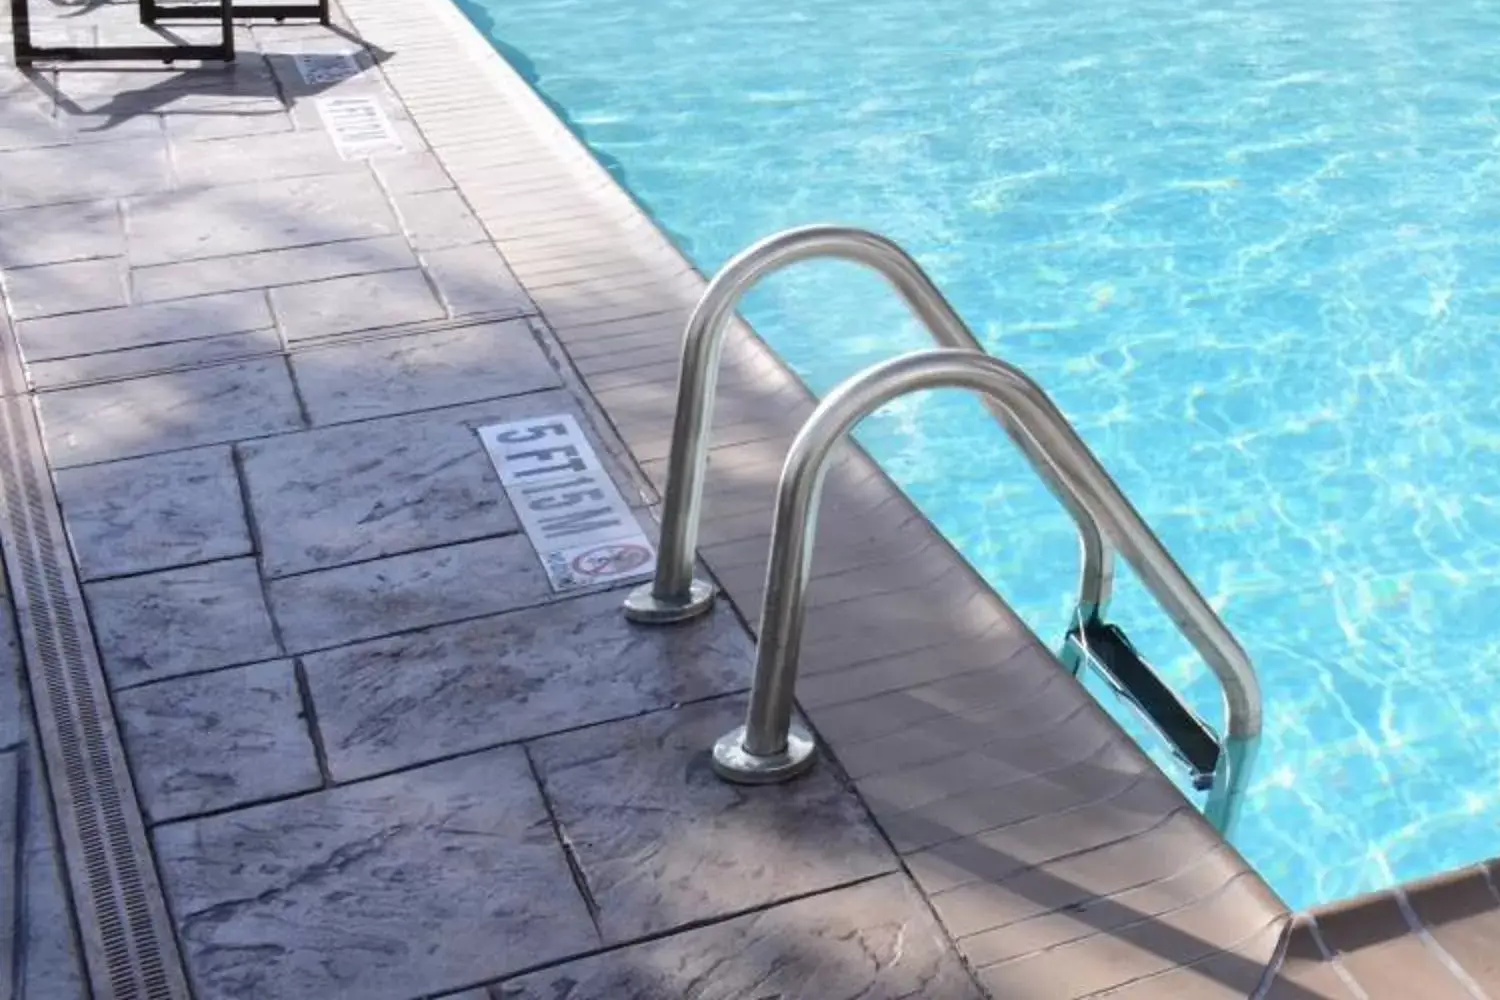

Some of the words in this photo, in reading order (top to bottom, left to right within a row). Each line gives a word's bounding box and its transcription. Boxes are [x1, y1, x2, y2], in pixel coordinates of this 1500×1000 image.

[497, 423, 568, 443] 5
[506, 445, 587, 478] FT
[538, 507, 621, 539] M
